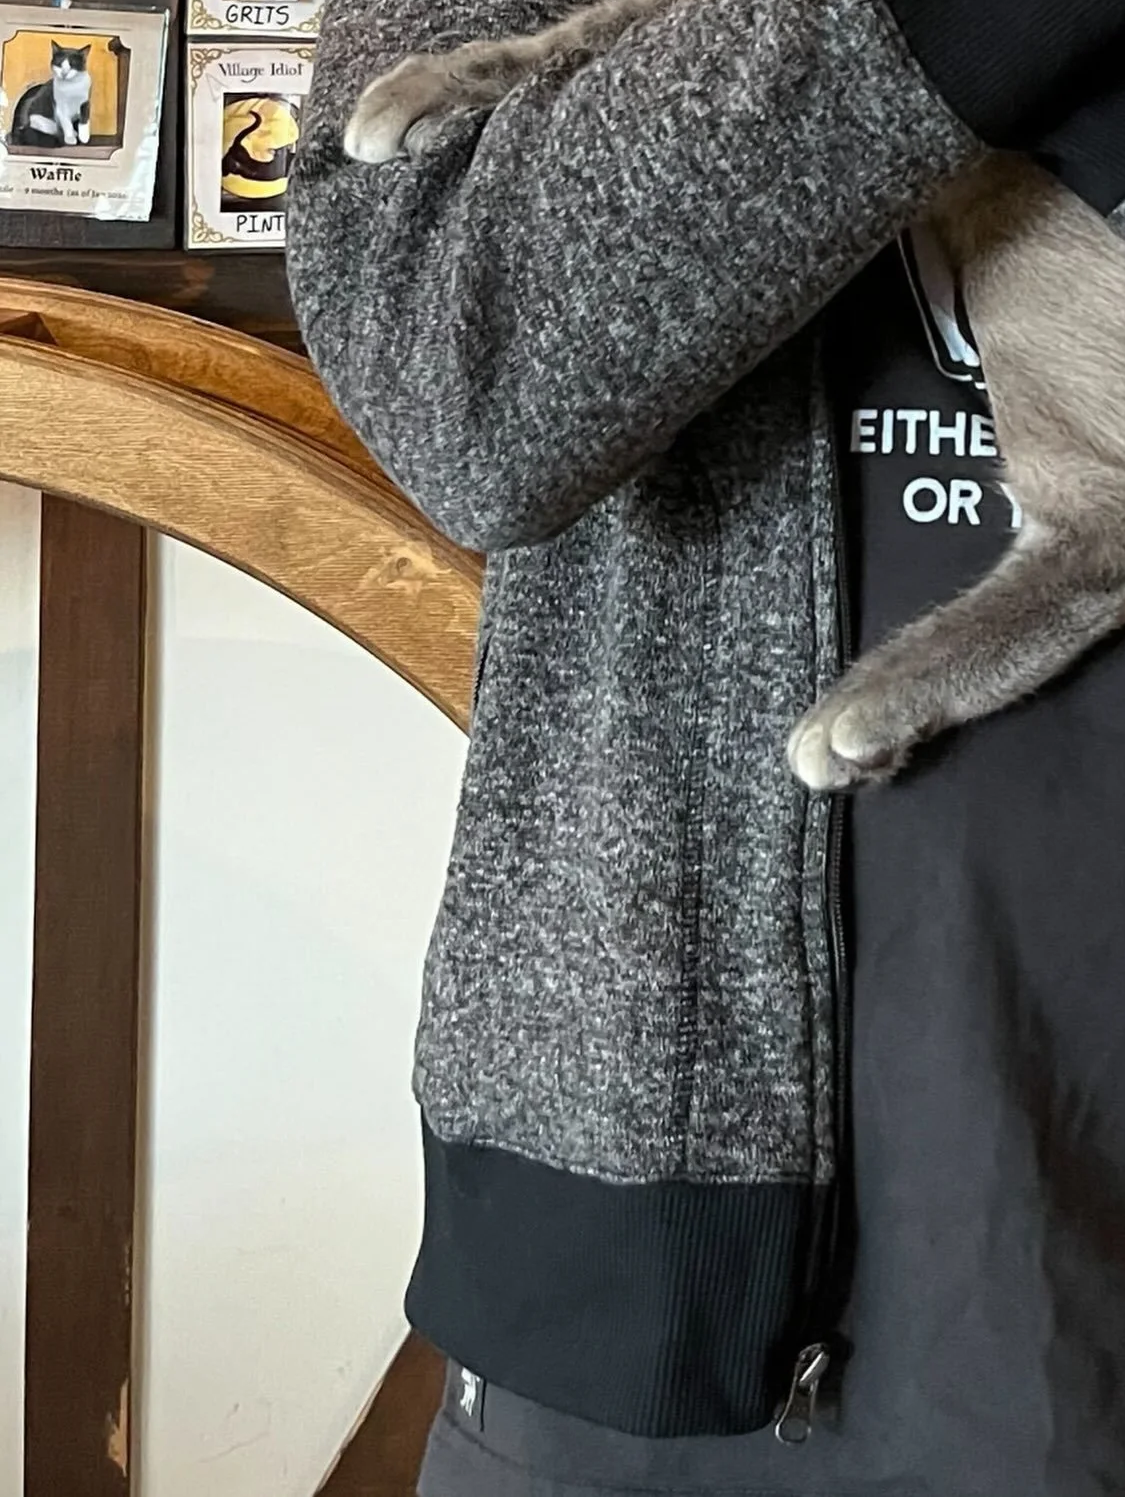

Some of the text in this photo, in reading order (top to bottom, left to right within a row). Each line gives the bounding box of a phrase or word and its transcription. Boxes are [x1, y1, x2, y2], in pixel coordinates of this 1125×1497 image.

[225, 4, 290, 25] GRITS
[218, 62, 305, 83] Village Idiot
[29, 167, 82, 182] Waffle
[849, 407, 998, 457] EITHE
[902, 477, 983, 526] OR
